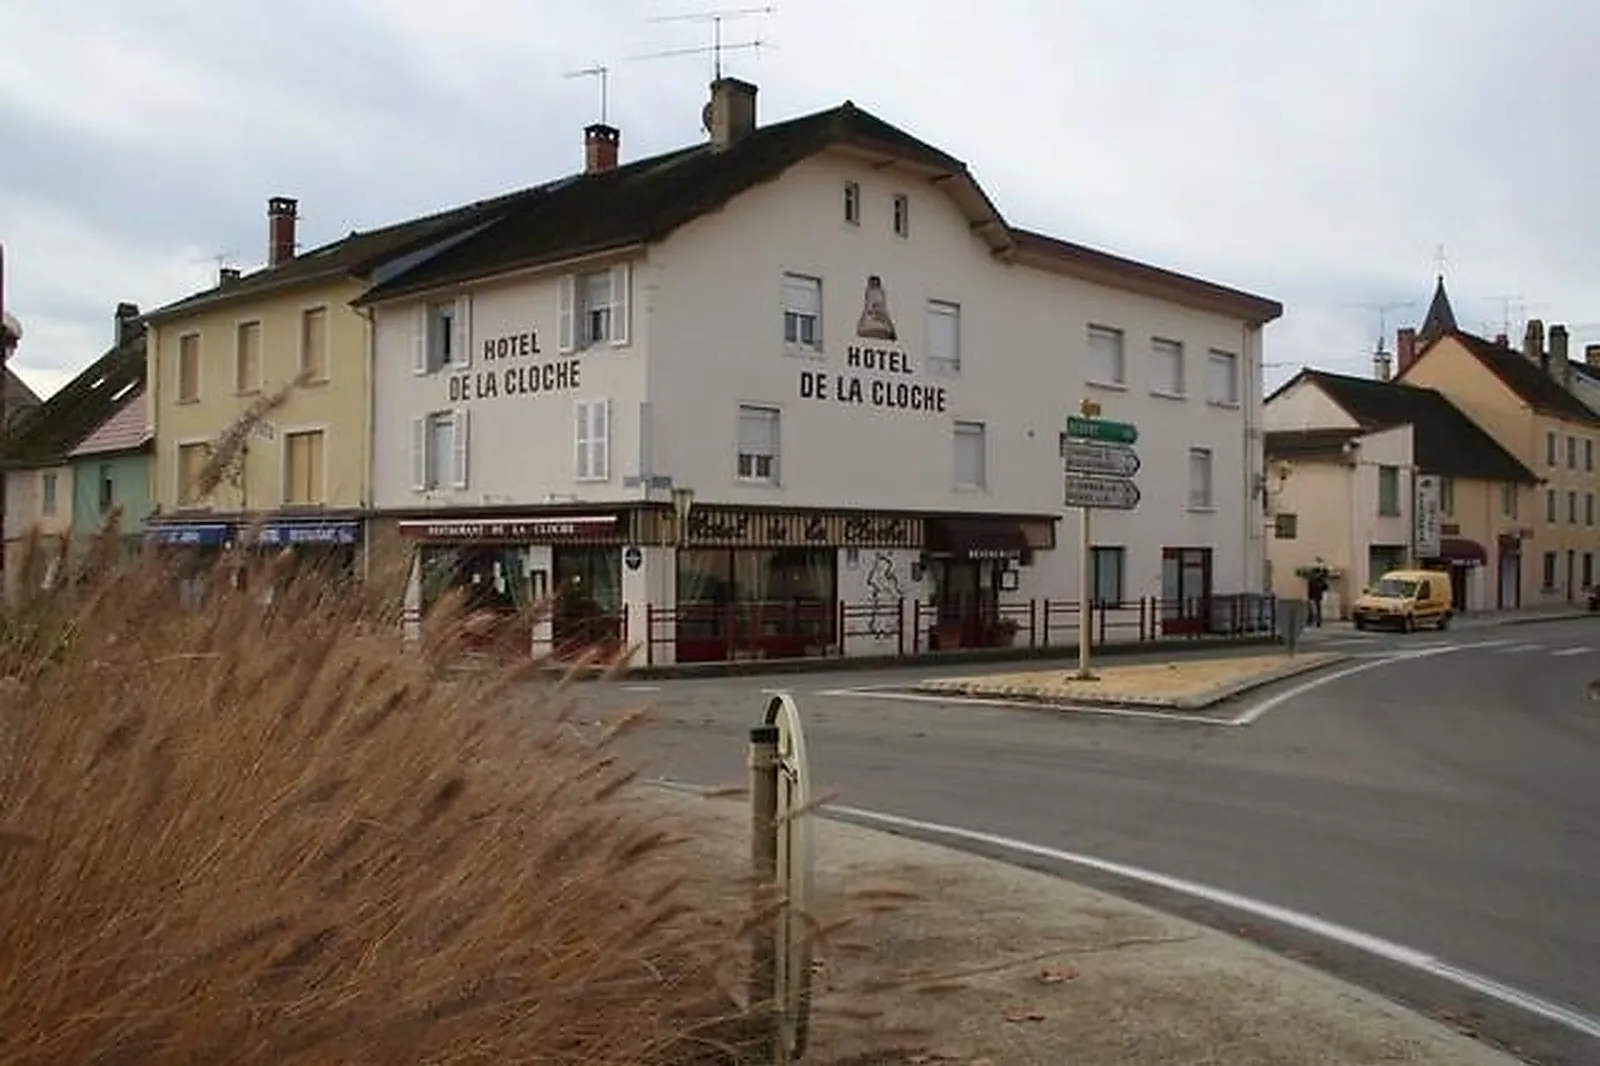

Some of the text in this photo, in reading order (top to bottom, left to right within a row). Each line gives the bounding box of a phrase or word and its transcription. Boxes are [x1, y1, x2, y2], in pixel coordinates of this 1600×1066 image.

[484, 332, 541, 360] HOTEL
[847, 346, 914, 374] HOTEL
[449, 360, 580, 401] DE LA CLOCHE
[800, 371, 946, 413] DE LA CLOCHE
